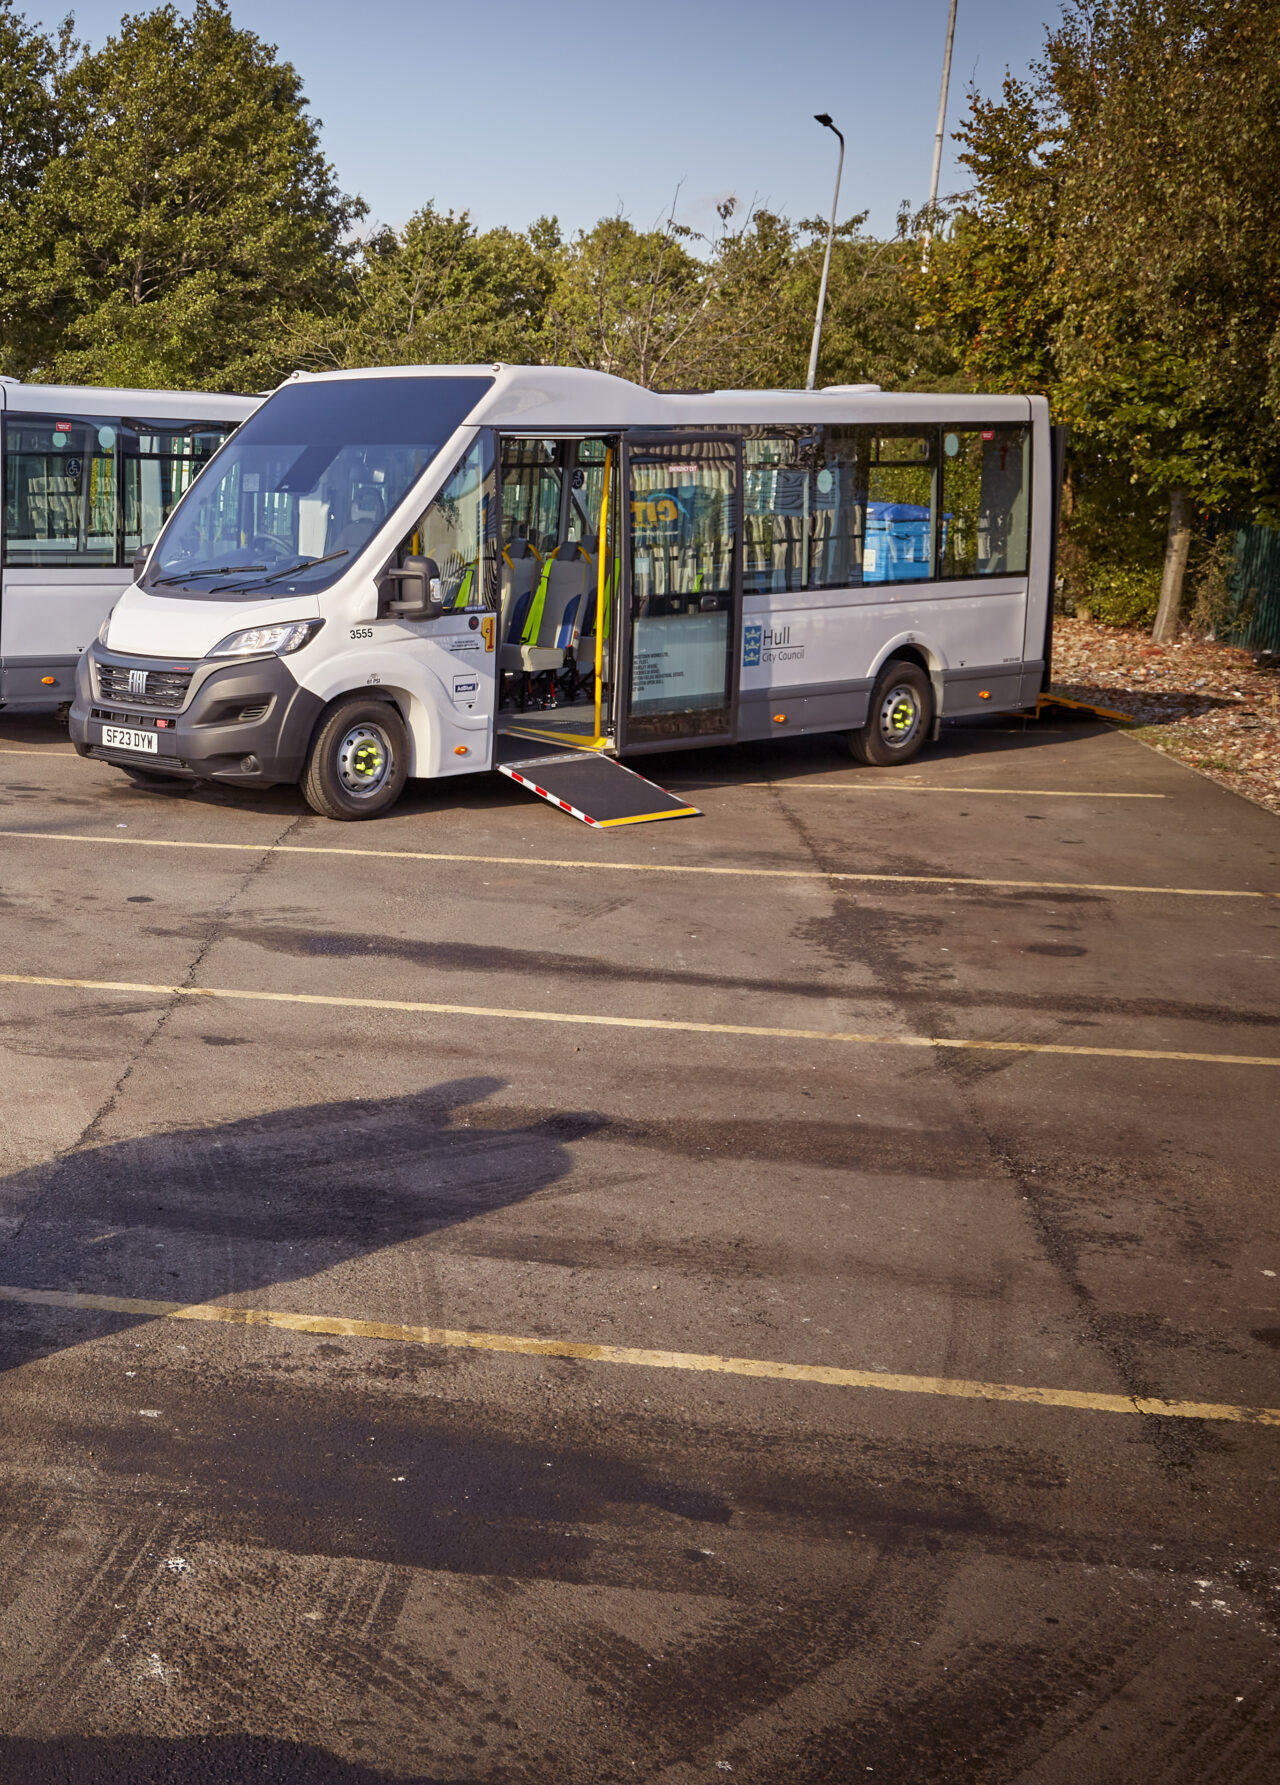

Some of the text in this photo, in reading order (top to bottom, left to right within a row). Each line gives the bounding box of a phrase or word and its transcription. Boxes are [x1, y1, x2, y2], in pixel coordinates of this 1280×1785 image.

[350, 628, 373, 640] 3555
[763, 626, 790, 646] Hull
[762, 648, 804, 664] City Council
[128, 670, 148, 694] FIAT
[106, 728, 152, 750] SF23 DYW
